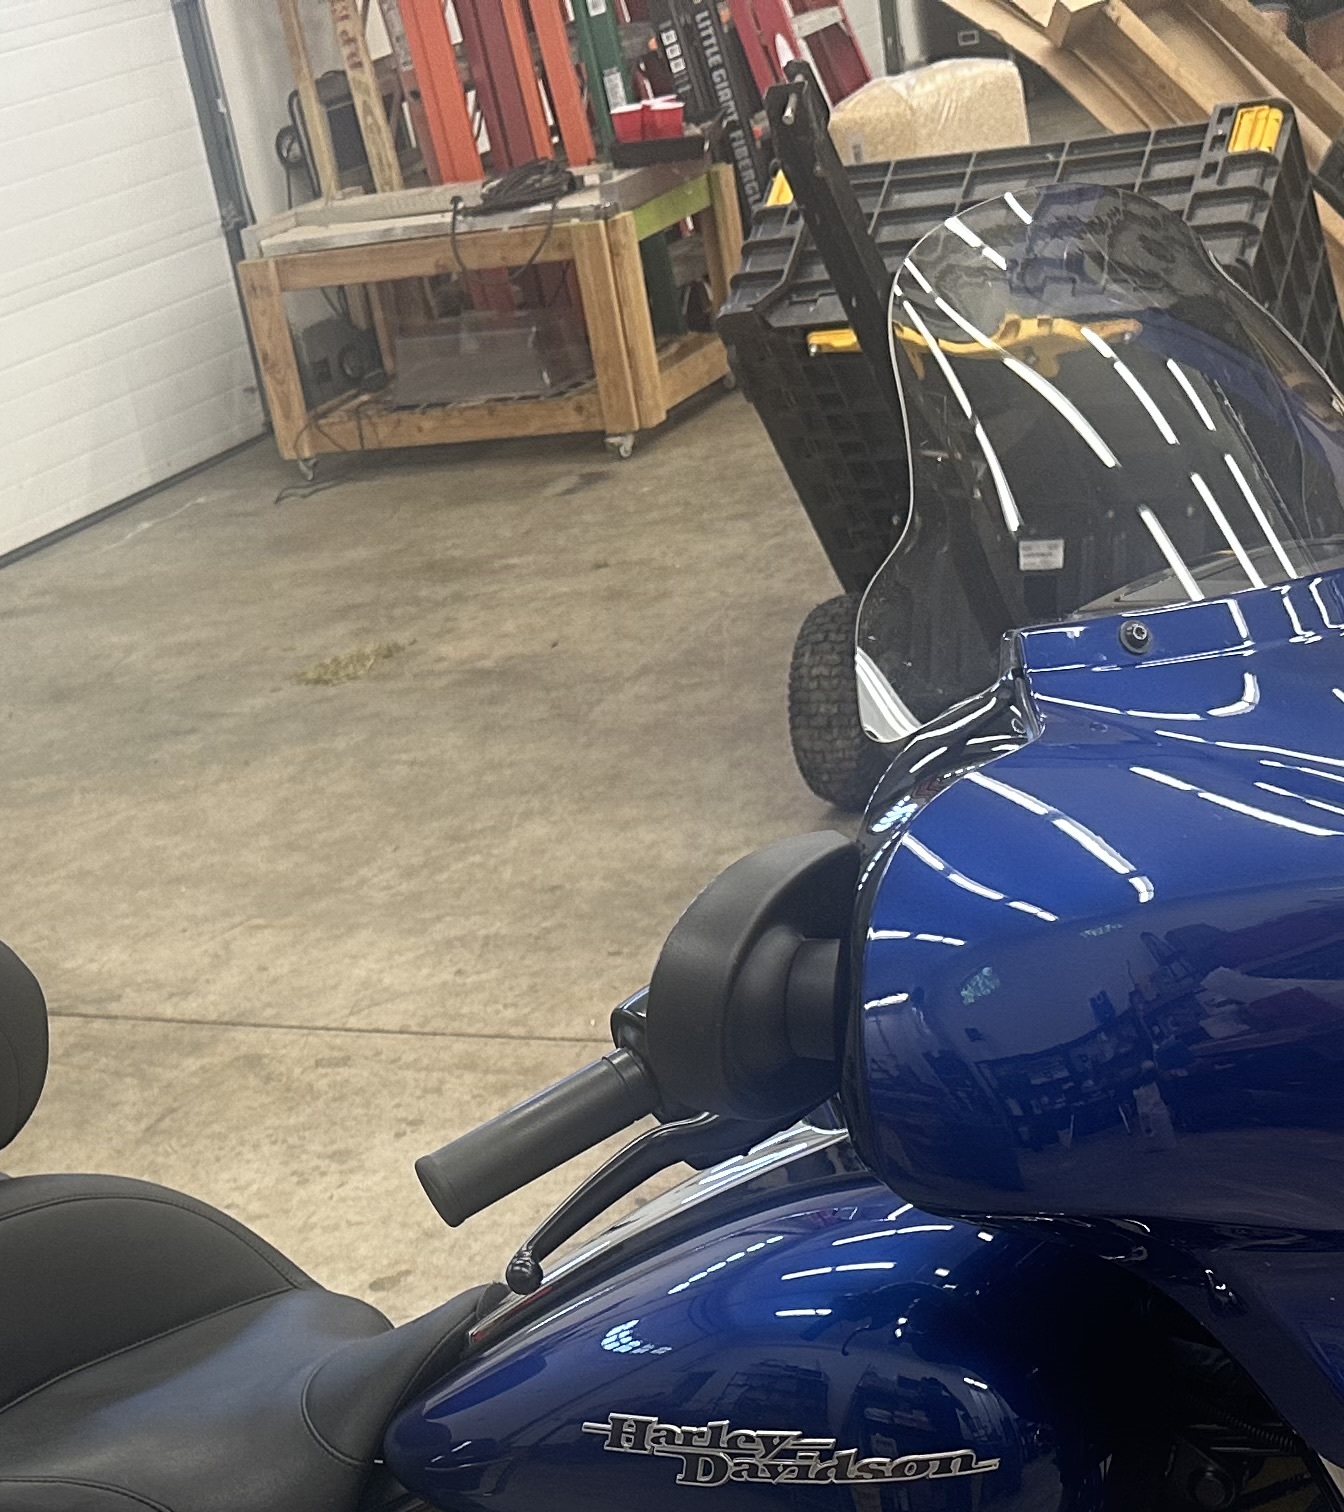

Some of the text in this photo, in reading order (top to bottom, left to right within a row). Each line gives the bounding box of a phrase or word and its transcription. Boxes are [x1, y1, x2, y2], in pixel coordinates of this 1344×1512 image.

[695, 10, 723, 68] LITTLE
[711, 68, 739, 124] GIANT
[583, 1412, 836, 1461] Harley
[675, 1447, 1001, 1487] Davidson
